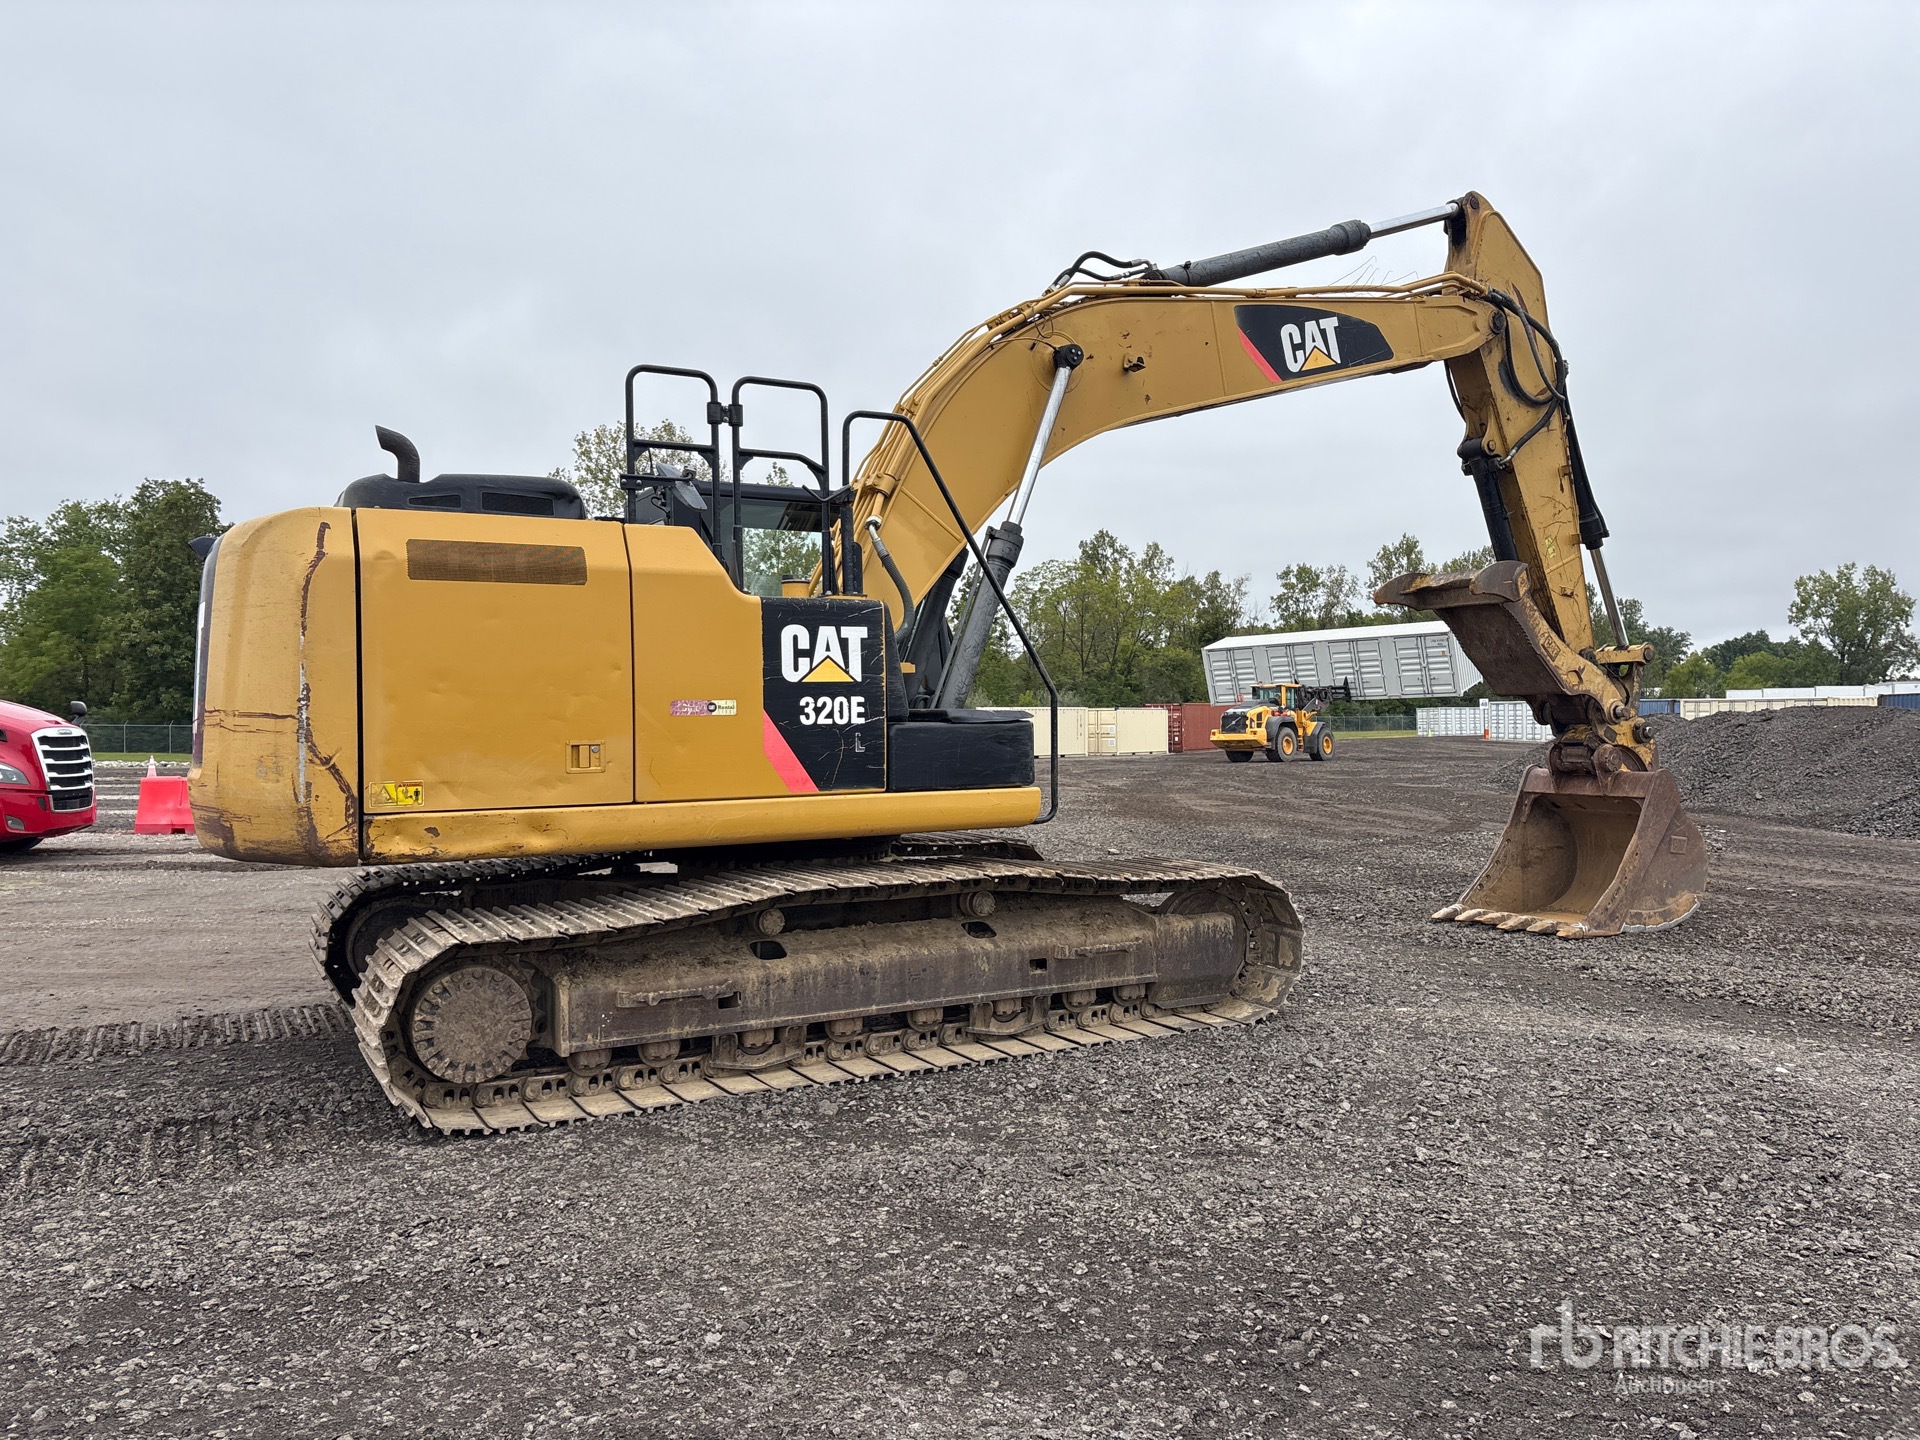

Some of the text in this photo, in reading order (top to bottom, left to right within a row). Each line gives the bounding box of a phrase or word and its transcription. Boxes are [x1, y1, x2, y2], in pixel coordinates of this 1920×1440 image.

[1280, 316, 1341, 373] CAT
[781, 624, 868, 682] CAT
[799, 695, 866, 726] 320E
[855, 732, 866, 753] L
